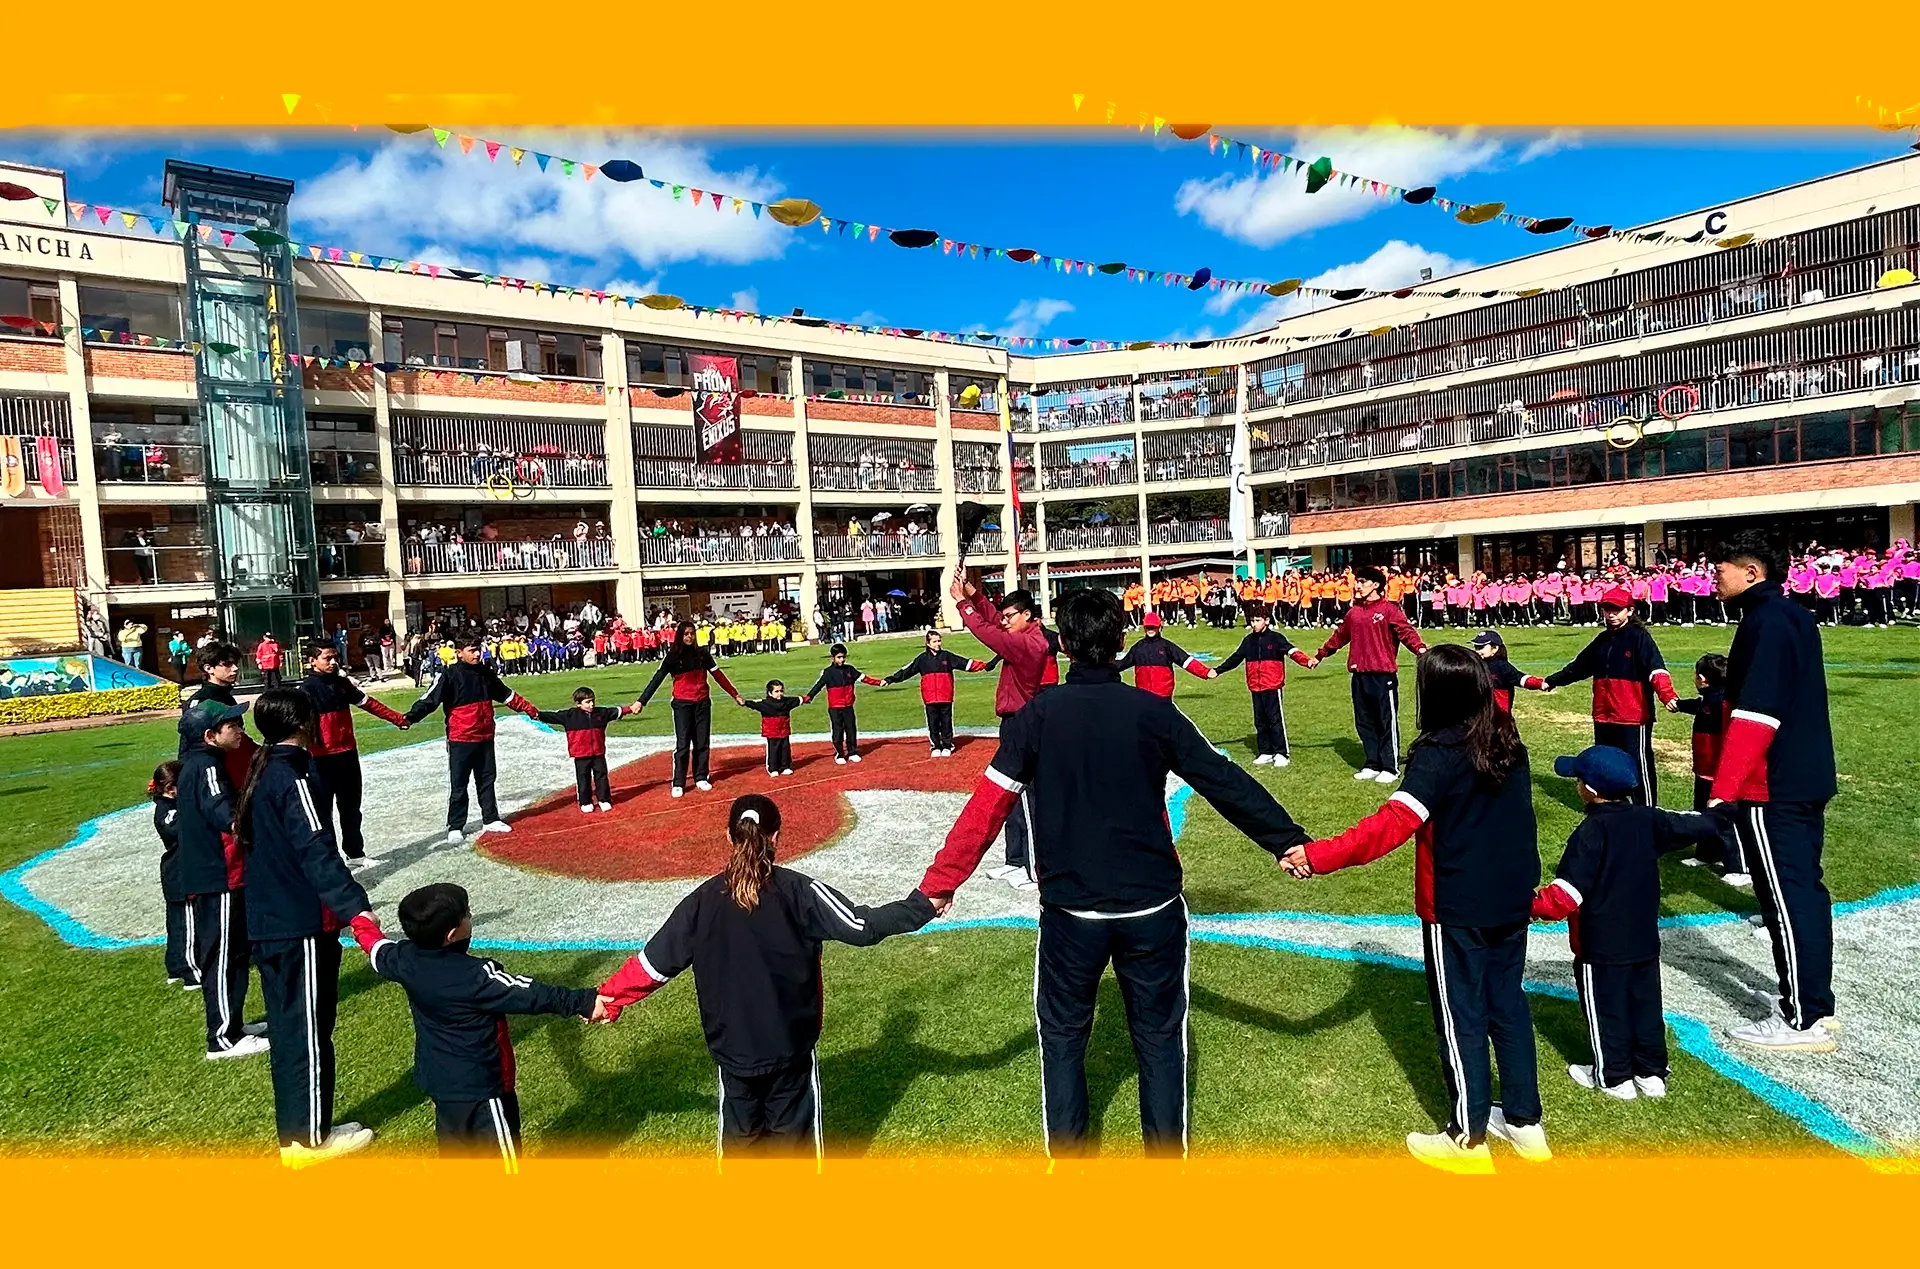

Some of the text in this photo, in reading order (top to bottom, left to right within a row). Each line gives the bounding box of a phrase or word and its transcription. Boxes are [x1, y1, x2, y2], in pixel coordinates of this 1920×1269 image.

[1705, 211, 1727, 235] C
[0, 232, 94, 260] ANCHA
[693, 372, 732, 392] PROM
